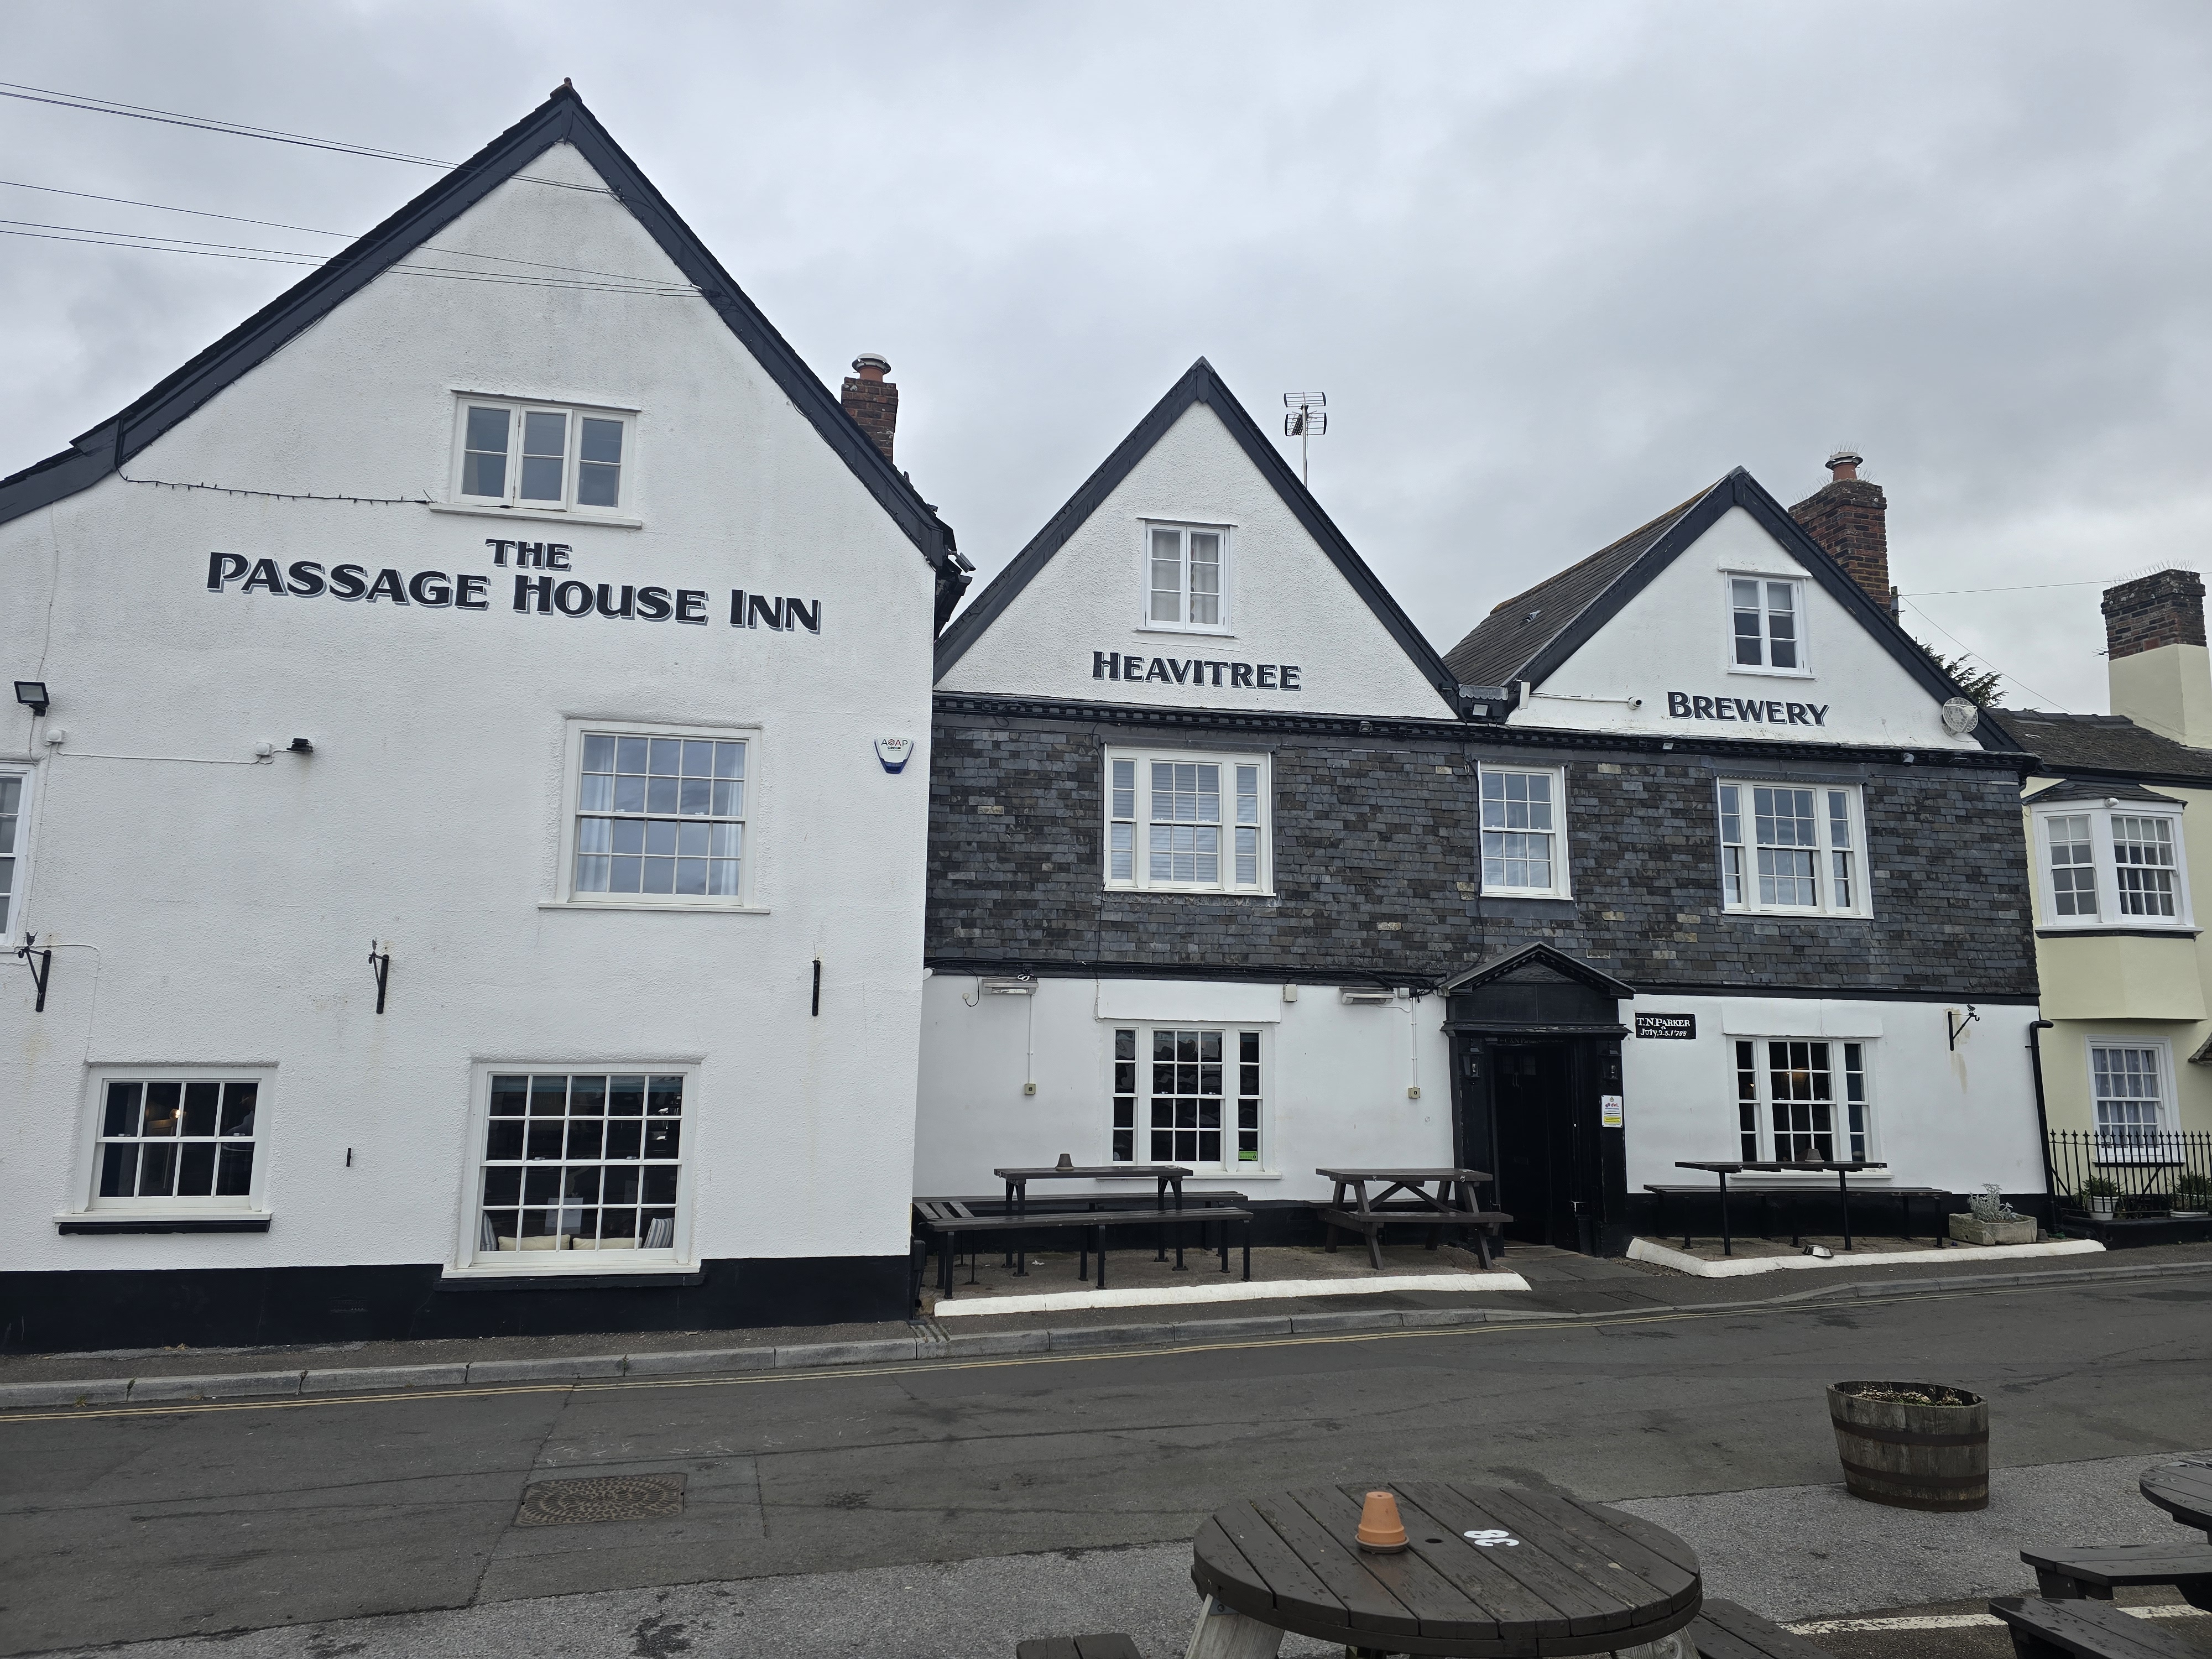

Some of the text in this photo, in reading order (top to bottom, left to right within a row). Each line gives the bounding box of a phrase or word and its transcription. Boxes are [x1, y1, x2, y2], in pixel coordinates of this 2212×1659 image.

[485, 539, 573, 572] THE
[206, 551, 822, 634] PASSAGE HOUSE INN
[1092, 651, 1302, 691] HEAVITREE
[1667, 691, 1830, 727] BREWERY
[881, 739, 908, 747] ASAP
